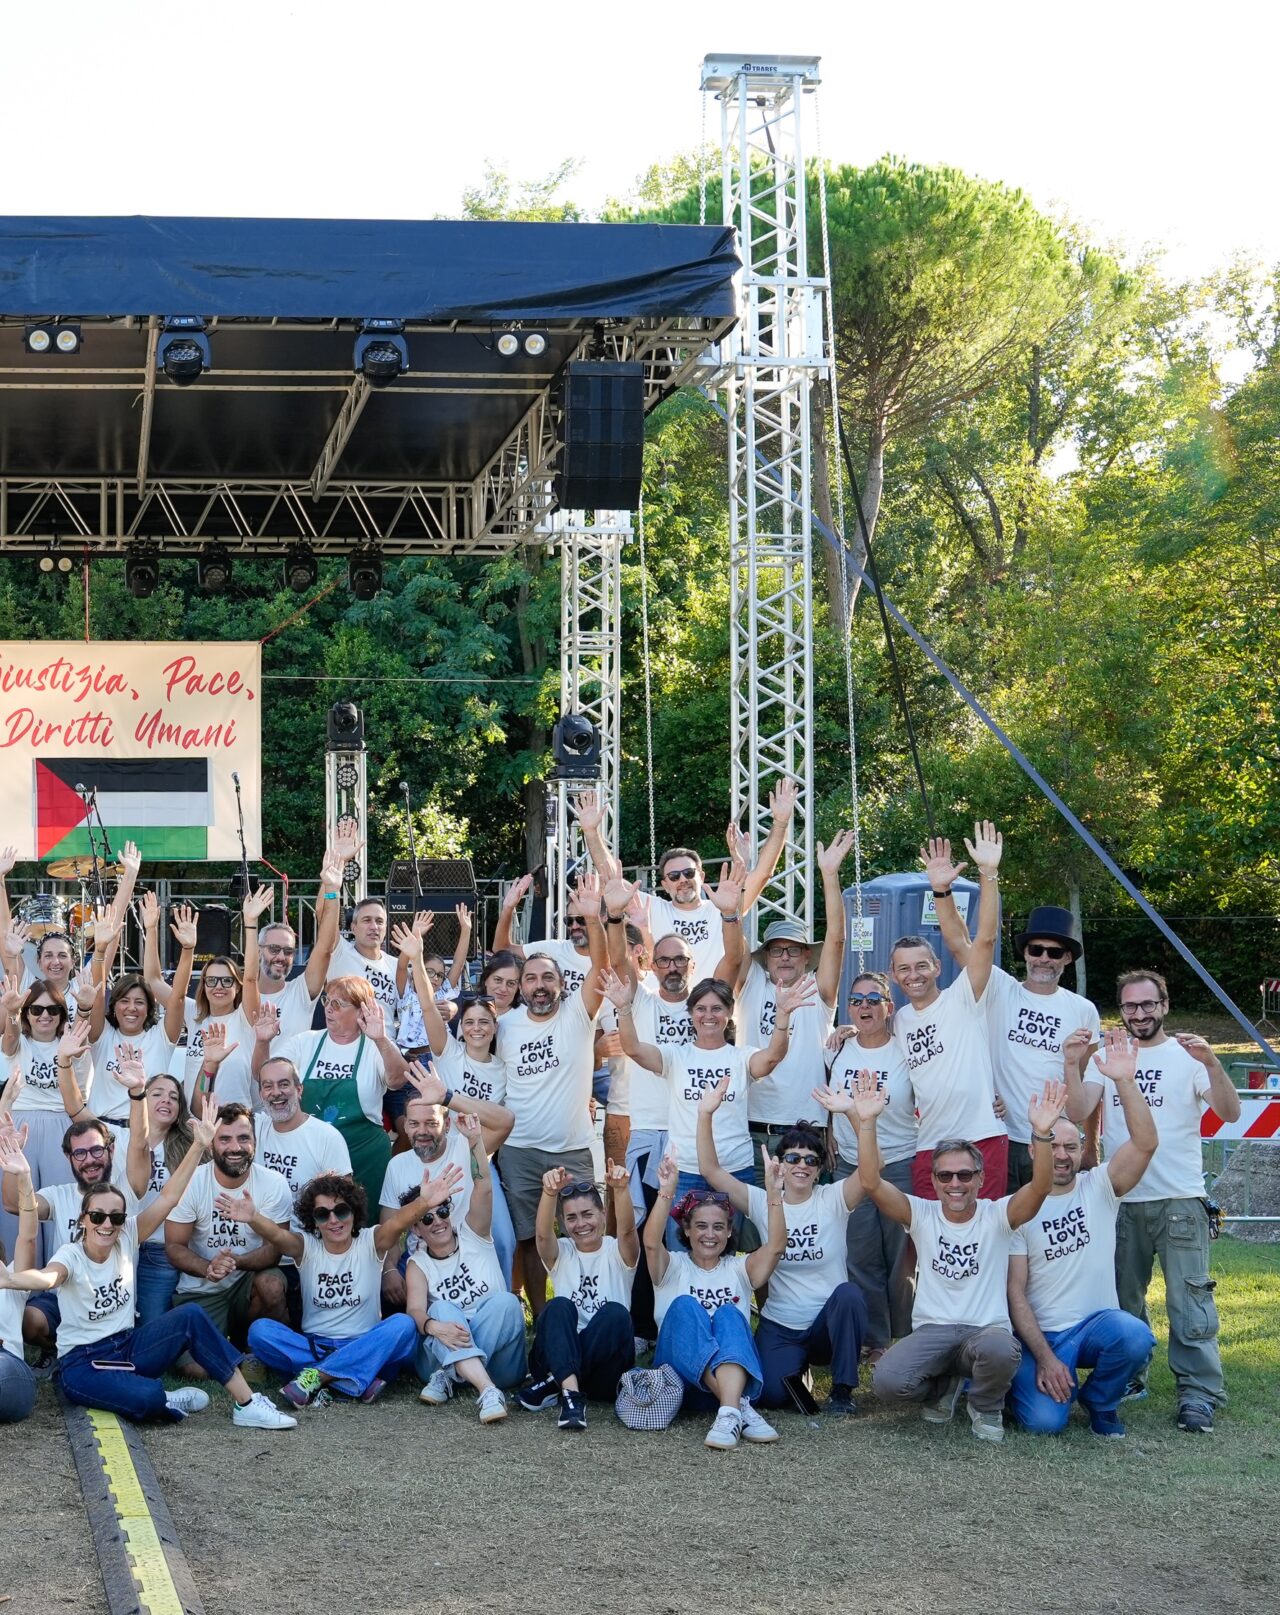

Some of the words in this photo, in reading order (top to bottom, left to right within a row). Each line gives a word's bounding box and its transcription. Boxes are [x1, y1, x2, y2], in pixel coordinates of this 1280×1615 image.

[162, 655, 256, 702] Pace,
[135, 707, 238, 751] Umani
[564, 970, 585, 982] PEA
[564, 981, 580, 992] LO
[1018, 1008, 1062, 1029] PEACE
[659, 1026, 695, 1037] LOVE
[1017, 1020, 1057, 1039] LOVE
[520, 1035, 554, 1054] PEACE
[1007, 1029, 1060, 1053] EducAid
[521, 1047, 554, 1064] LOVE
[907, 1041, 945, 1070] EducAid
[316, 1060, 355, 1073] PEACE
[517, 1056, 560, 1077] EducAid
[688, 1068, 731, 1079] PEACE
[24, 1074, 59, 1090] EducAi
[316, 1072, 353, 1080] LOVE
[845, 1069, 888, 1081] PECE
[1134, 1069, 1162, 1081] ACE
[691, 1077, 721, 1090] LOV
[462, 1084, 491, 1101] LOVE
[684, 1088, 736, 1102] Eduid
[264, 1151, 298, 1167] PEACE
[1041, 1206, 1085, 1233] PEACE
[1048, 1220, 1087, 1246] LOVE
[787, 1237, 815, 1249] OVE
[938, 1249, 976, 1268] LOVE
[317, 1271, 354, 1287] PEACE
[318, 1284, 353, 1299] LOVE
[690, 1285, 733, 1300] PEACE
